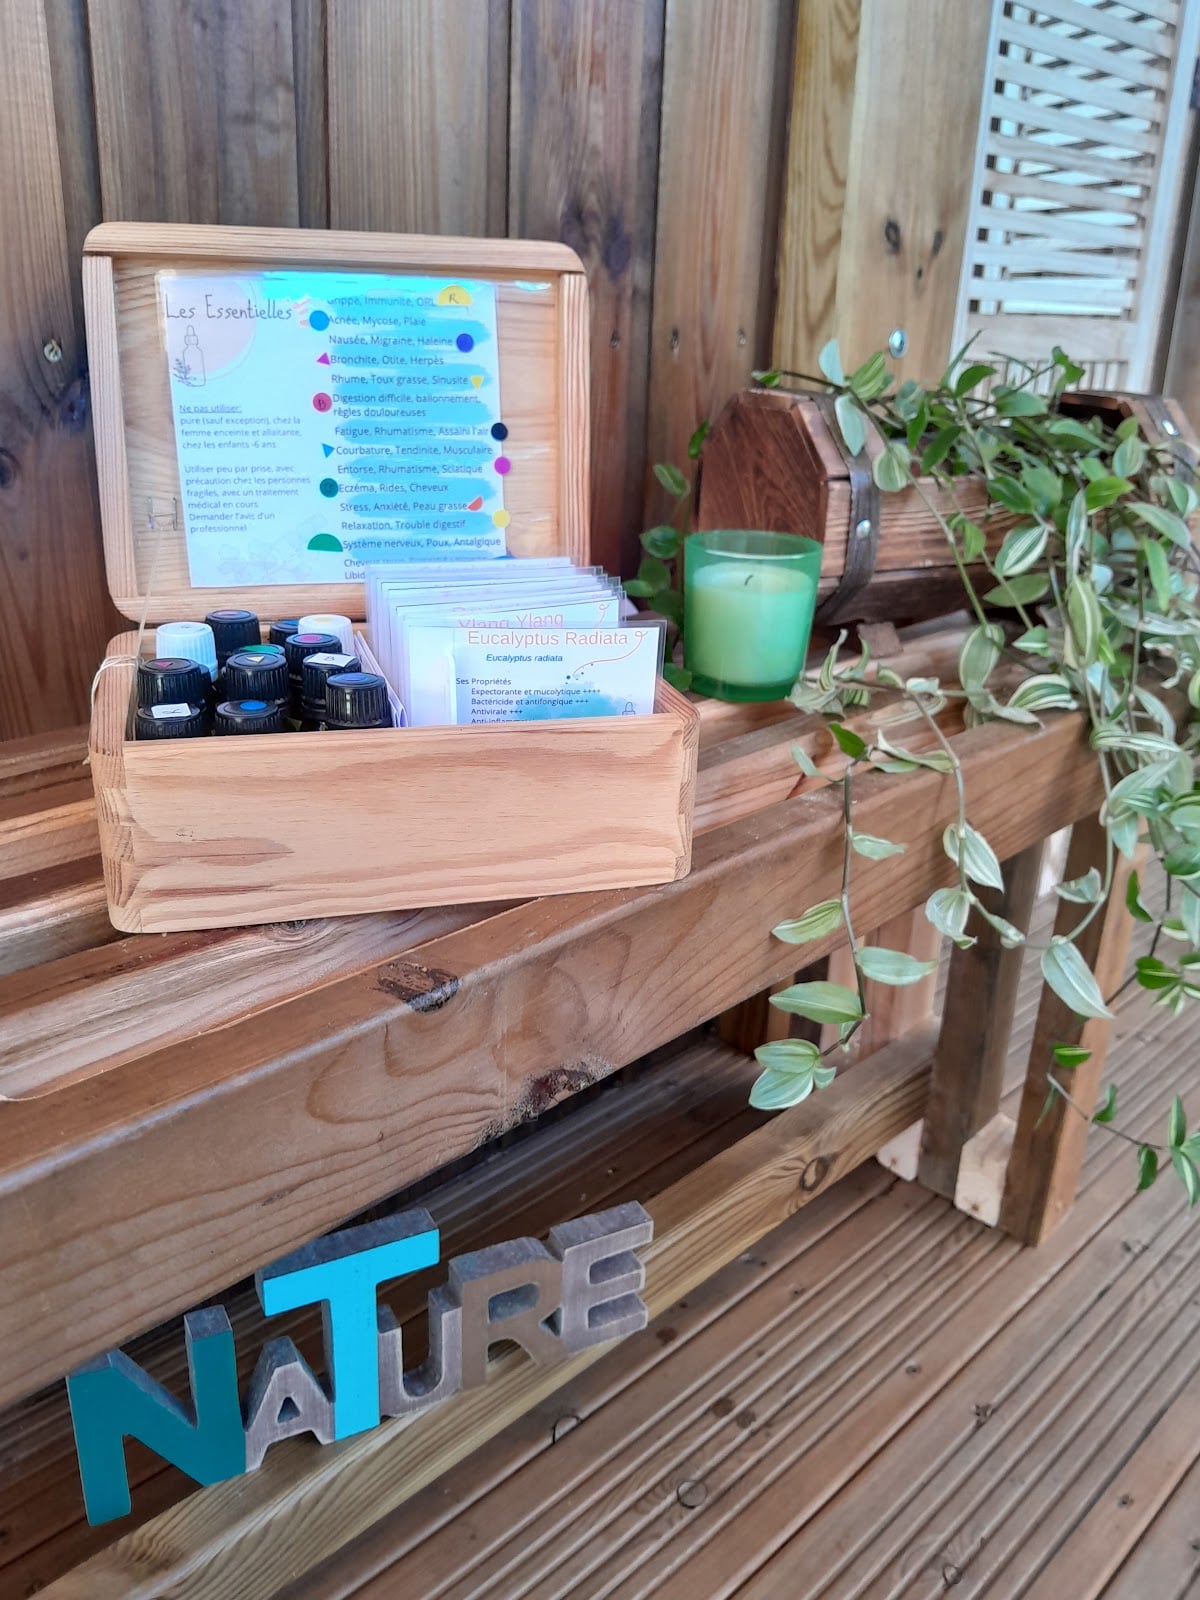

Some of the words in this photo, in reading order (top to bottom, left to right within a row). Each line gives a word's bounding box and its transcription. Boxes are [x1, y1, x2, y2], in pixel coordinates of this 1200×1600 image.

[165, 293, 196, 319] Les
[204, 294, 292, 320] Essentielles
[362, 315, 402, 328] Mycose,
[403, 316, 427, 326] Plaie
[329, 335, 369, 346] Nausée,
[371, 336, 415, 348] Migraine,
[417, 336, 453, 346] Haleine
[330, 354, 378, 365] Bronchite,
[382, 355, 408, 365] Otite,
[410, 355, 445, 367] Herpès
[331, 374, 368, 385] Rhume,
[371, 375, 393, 384] Toux
[396, 376, 430, 387] grasse,
[432, 375, 468, 385] Sinusite
[332, 393, 375, 404] Digestion
[378, 393, 414, 404] difficile,
[416, 394, 481, 404] ballonnement,
[180, 405, 191, 413] Ne
[194, 405, 209, 414] pas
[333, 407, 362, 418] règles
[364, 408, 427, 417] douloureuses
[180, 416, 201, 426] pure
[273, 415, 292, 424] chez
[293, 415, 301, 424] la
[181, 428, 211, 437] femme
[214, 429, 249, 437] enceinte
[251, 429, 260, 437] et
[335, 427, 372, 438] Fatigue,
[375, 426, 436, 437] Rhumatisme,
[182, 440, 202, 449] chez
[204, 440, 216, 449] les
[218, 440, 250, 449] enfants
[262, 441, 276, 449] ans
[336, 445, 392, 456] Courbature,
[395, 446, 441, 456] Tendinite,
[443, 445, 493, 455] Musculaire
[184, 465, 214, 473] Utiliser
[216, 466, 232, 475] peu
[235, 466, 248, 475] par
[337, 465, 375, 475] Entorse,
[378, 464, 440, 475] Rhumatisme,
[442, 464, 483, 476] Sciatique
[186, 477, 231, 487] précaution
[234, 477, 252, 485] chez
[254, 476, 266, 485] les
[267, 477, 311, 486] personnes
[187, 489, 219, 499] fragiles,
[222, 490, 240, 498] avec
[255, 488, 299, 497] traitement
[338, 483, 377, 494] Eczéma,
[380, 483, 407, 493] Rides,
[409, 483, 449, 492] Cheveux
[188, 500, 221, 509] médical
[223, 501, 234, 509] en
[340, 502, 371, 513] Stress,
[373, 501, 410, 512] Anxiété,
[413, 501, 437, 511] Peau
[438, 503, 468, 514] grasse
[189, 512, 233, 521] Demander
[190, 524, 247, 535] professionnel
[342, 521, 393, 531] Relaxation,
[395, 520, 430, 530] Trouble
[433, 519, 466, 530] digestif
[343, 539, 383, 551] Système
[385, 540, 424, 549] nerveux,
[426, 539, 451, 549] Poux,
[454, 537, 501, 549] Antalgique
[468, 630, 560, 649] Eucalyptus
[566, 630, 629, 646] Radiata
[486, 653, 532, 663] Eucalyptus
[534, 653, 563, 662] radiata
[456, 677, 469, 685] Ses
[471, 677, 512, 686] Propriétés
[471, 687, 522, 697] Expectorante
[524, 688, 532, 696] et
[533, 686, 581, 697] mucolytique
[471, 698, 513, 706] Bactéricide
[516, 698, 523, 706] et
[525, 698, 573, 708] antifongique
[471, 708, 507, 716] Antivirale
[66, 1200, 655, 1526] NATURE
